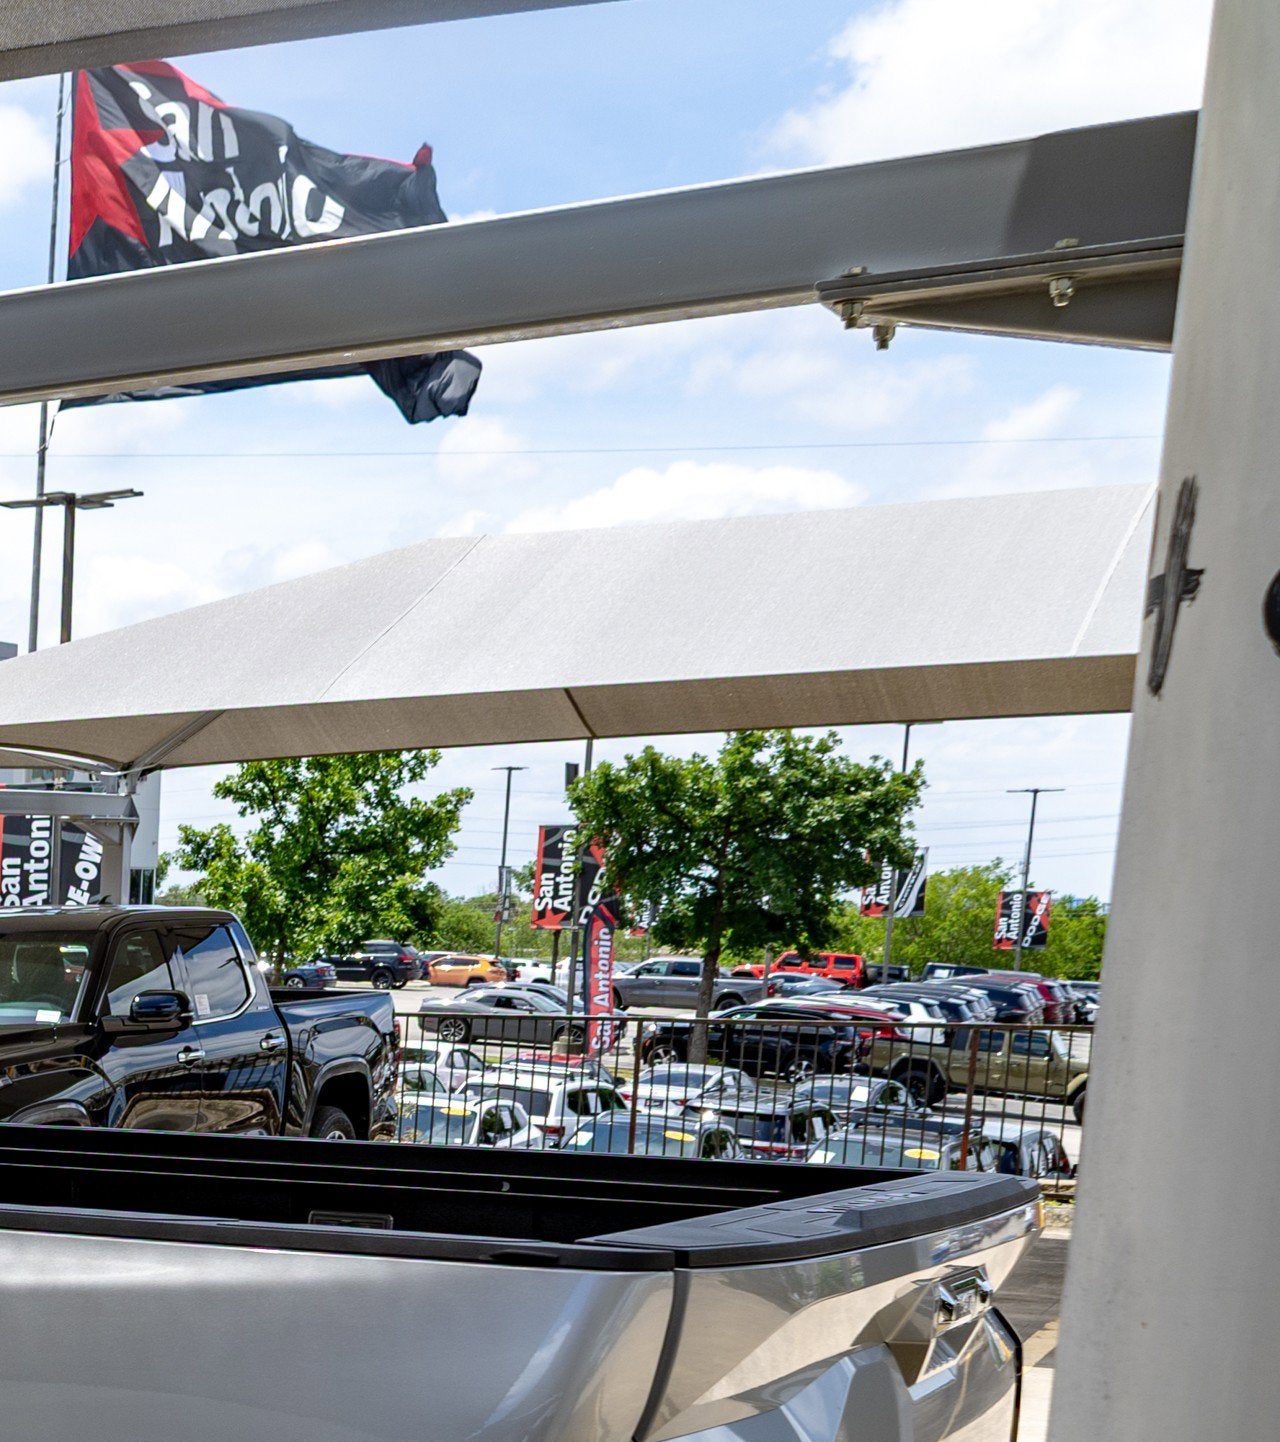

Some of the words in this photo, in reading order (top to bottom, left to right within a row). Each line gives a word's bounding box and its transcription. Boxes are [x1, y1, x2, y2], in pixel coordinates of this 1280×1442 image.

[23, 814, 52, 907] Antoni
[534, 872, 555, 912] San
[553, 829, 577, 912] Antonio
[1006, 893, 1022, 940] Antonio
[593, 927, 612, 1008] Antonio
